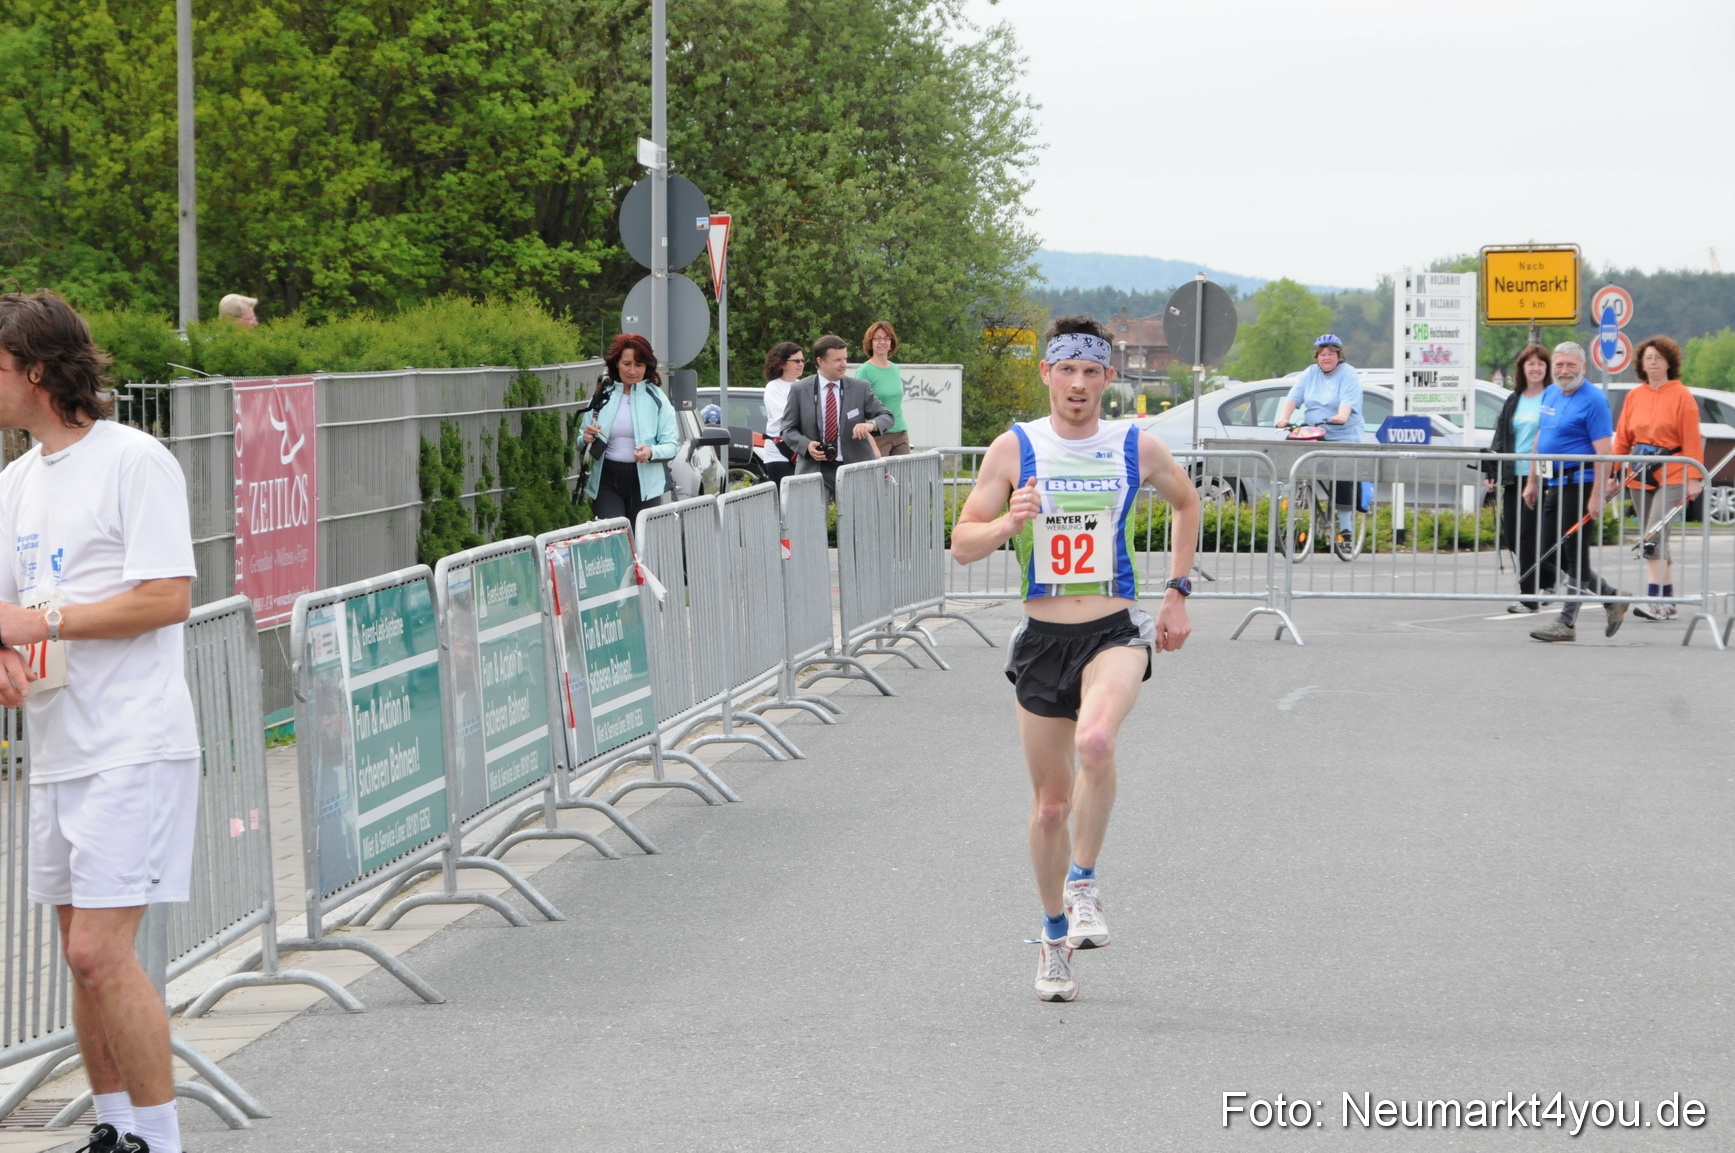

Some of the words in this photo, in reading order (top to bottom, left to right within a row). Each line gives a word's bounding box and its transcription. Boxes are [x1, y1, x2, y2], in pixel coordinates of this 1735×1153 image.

[1519, 262, 1544, 270] Nach
[1494, 275, 1568, 293] Neumarkt
[1519, 299, 1525, 308] 5
[1532, 299, 1545, 308] km
[1412, 371, 1438, 387] THULE
[1387, 428, 1426, 443] VOLVO
[1046, 478, 1121, 491] BOCK
[249, 473, 309, 535] ZEITLOS
[1046, 515, 1081, 524] MEYER
[1051, 533, 1095, 575] 92
[362, 617, 404, 646] Event-Leit-Systeme
[584, 622, 596, 651] Fun
[594, 618, 602, 648] &
[600, 613, 618, 646] Action
[615, 611, 624, 640] in
[482, 656, 493, 688] Fun
[493, 651, 499, 683] &
[500, 645, 516, 681] Action
[515, 642, 523, 674] in
[590, 662, 612, 695] sicheren
[609, 652, 632, 686] Bahnen!
[354, 704, 370, 741] Fun
[370, 698, 378, 735] &
[379, 690, 401, 731] Action
[401, 686, 411, 723] in
[485, 700, 508, 737] sicheren
[508, 688, 530, 726] Bahnen!
[359, 755, 390, 797] sicheren
[389, 736, 420, 783] Bahnen!
[379, 825, 395, 852] Service
